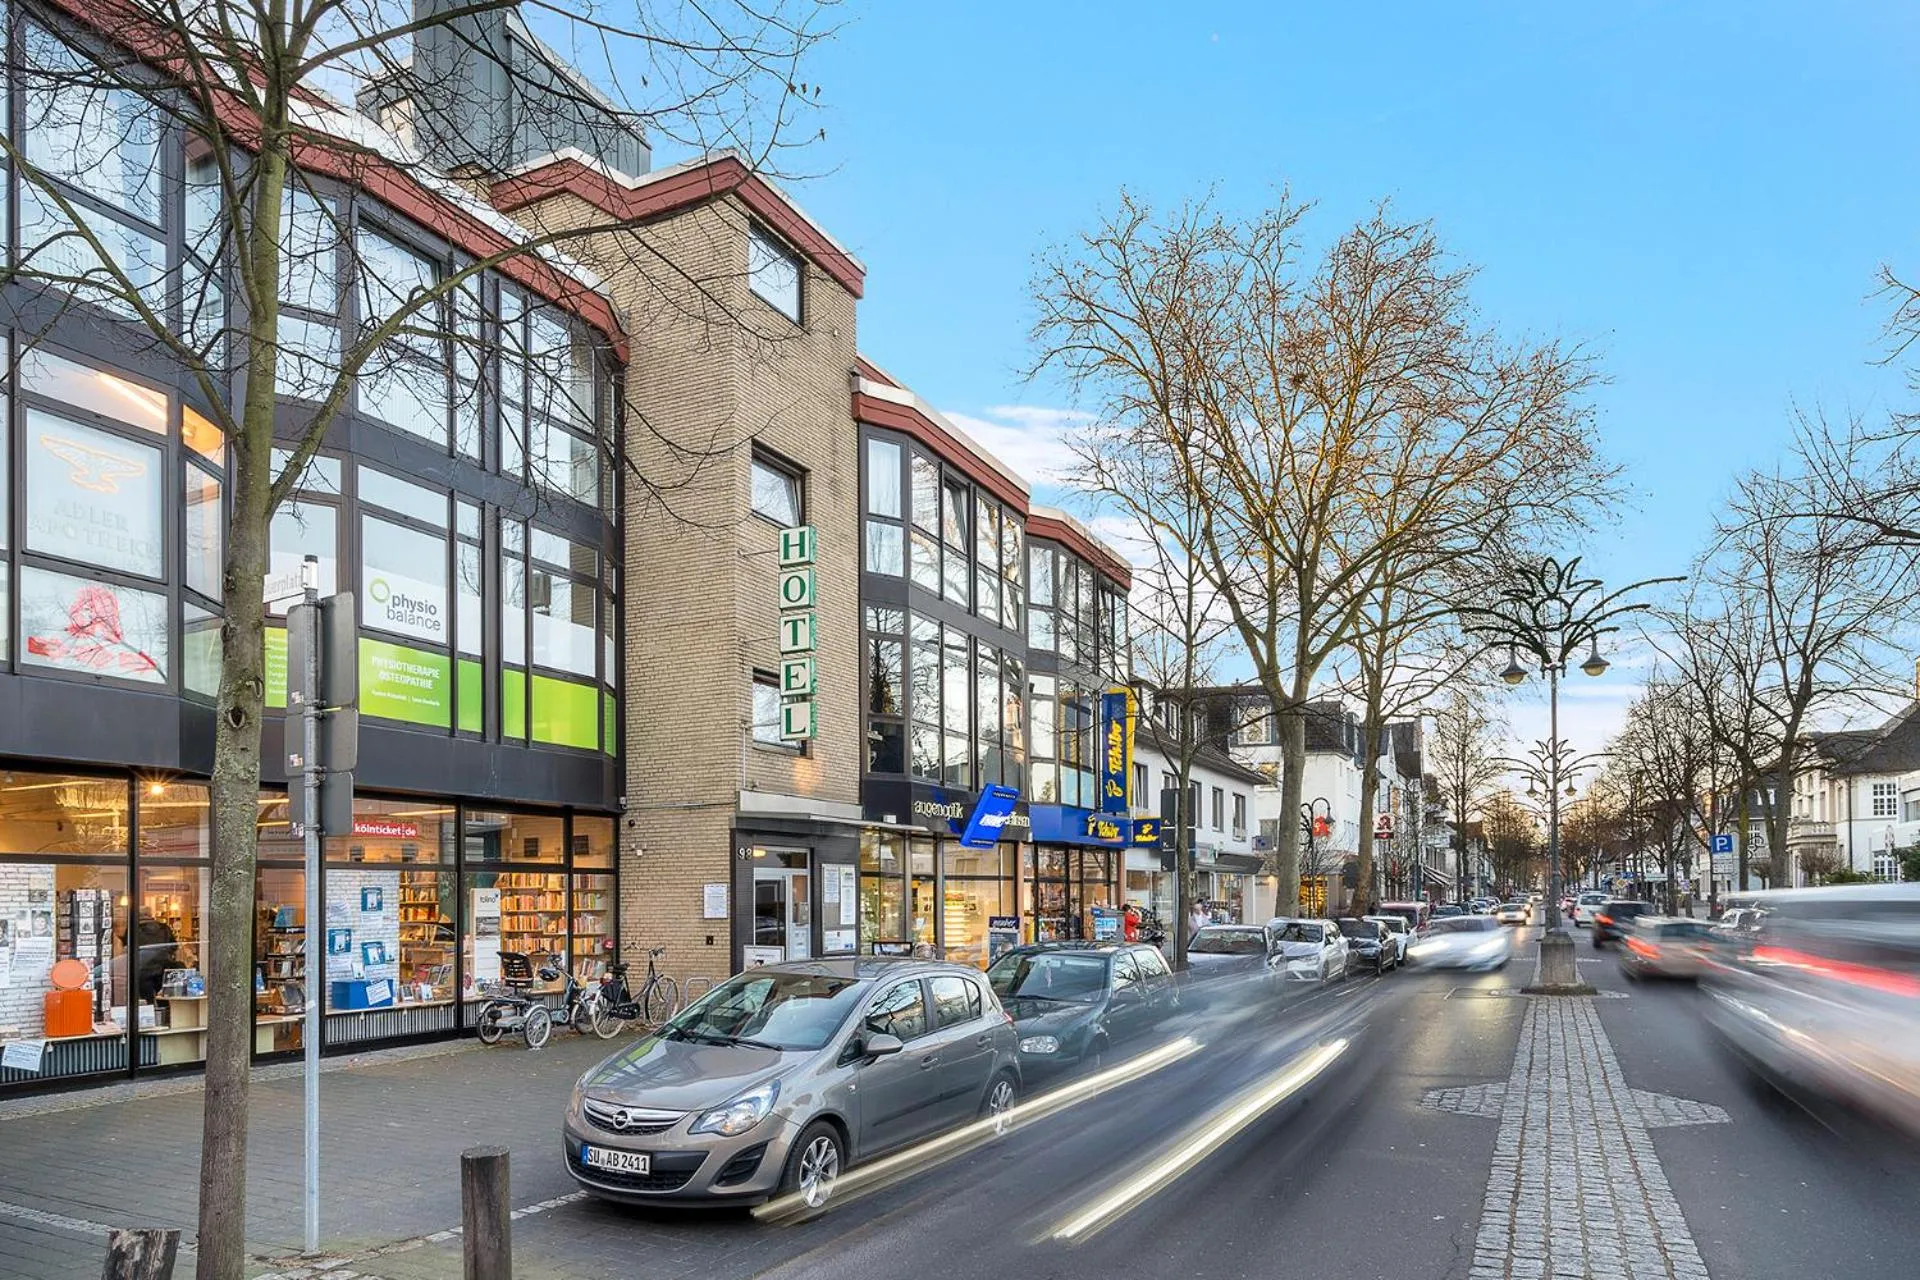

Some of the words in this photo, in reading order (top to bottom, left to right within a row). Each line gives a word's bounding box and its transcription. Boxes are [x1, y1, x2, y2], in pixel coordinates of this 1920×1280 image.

[53, 498, 129, 533] ADLER
[391, 593, 438, 616] physio
[386, 604, 441, 631] balance
[782, 530, 807, 735] HOTEL
[1107, 719, 1123, 775] Tchibo
[913, 799, 964, 821] augenoptik
[1716, 836, 1729, 852] P
[587, 1148, 600, 1163] SU
[606, 1151, 619, 1167] AB
[621, 1154, 647, 1172] 2411
